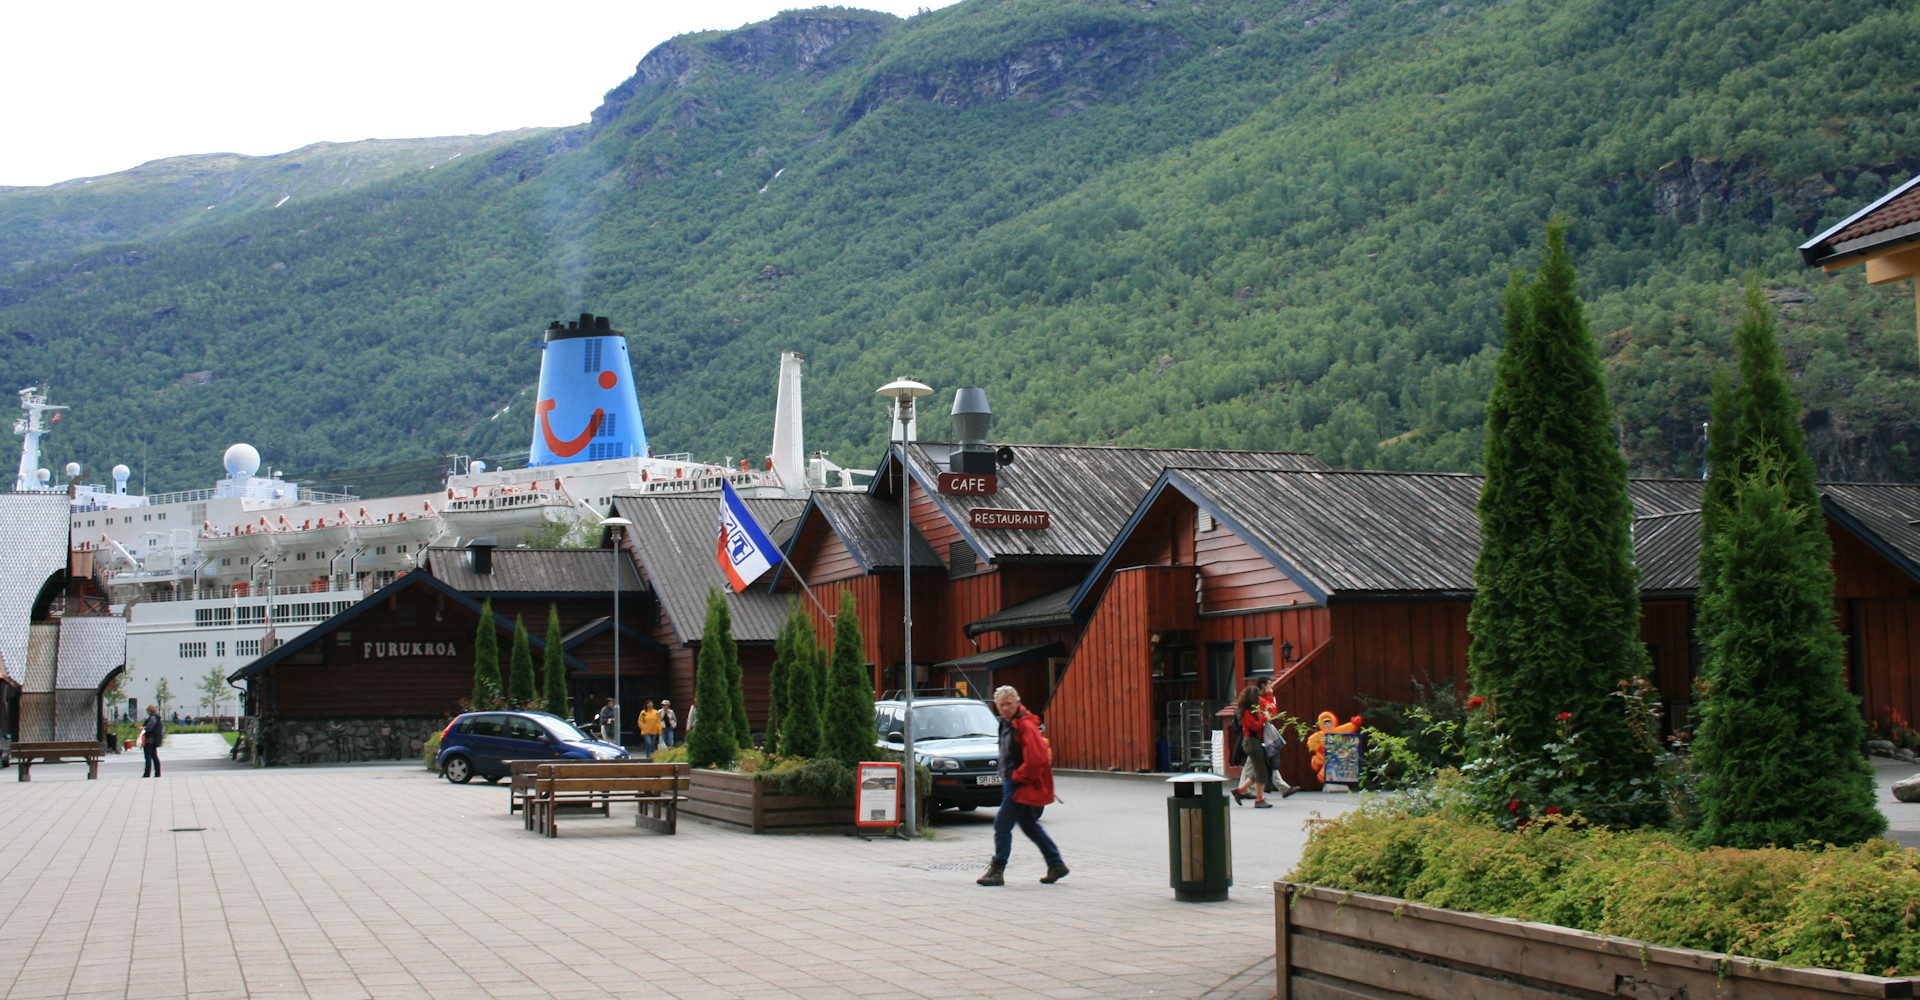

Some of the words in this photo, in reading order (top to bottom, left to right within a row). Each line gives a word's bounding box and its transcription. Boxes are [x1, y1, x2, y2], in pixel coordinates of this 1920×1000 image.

[950, 478, 986, 492] CAFE
[974, 513, 1045, 525] RESTAURANT
[363, 641, 457, 659] FURUKROA
